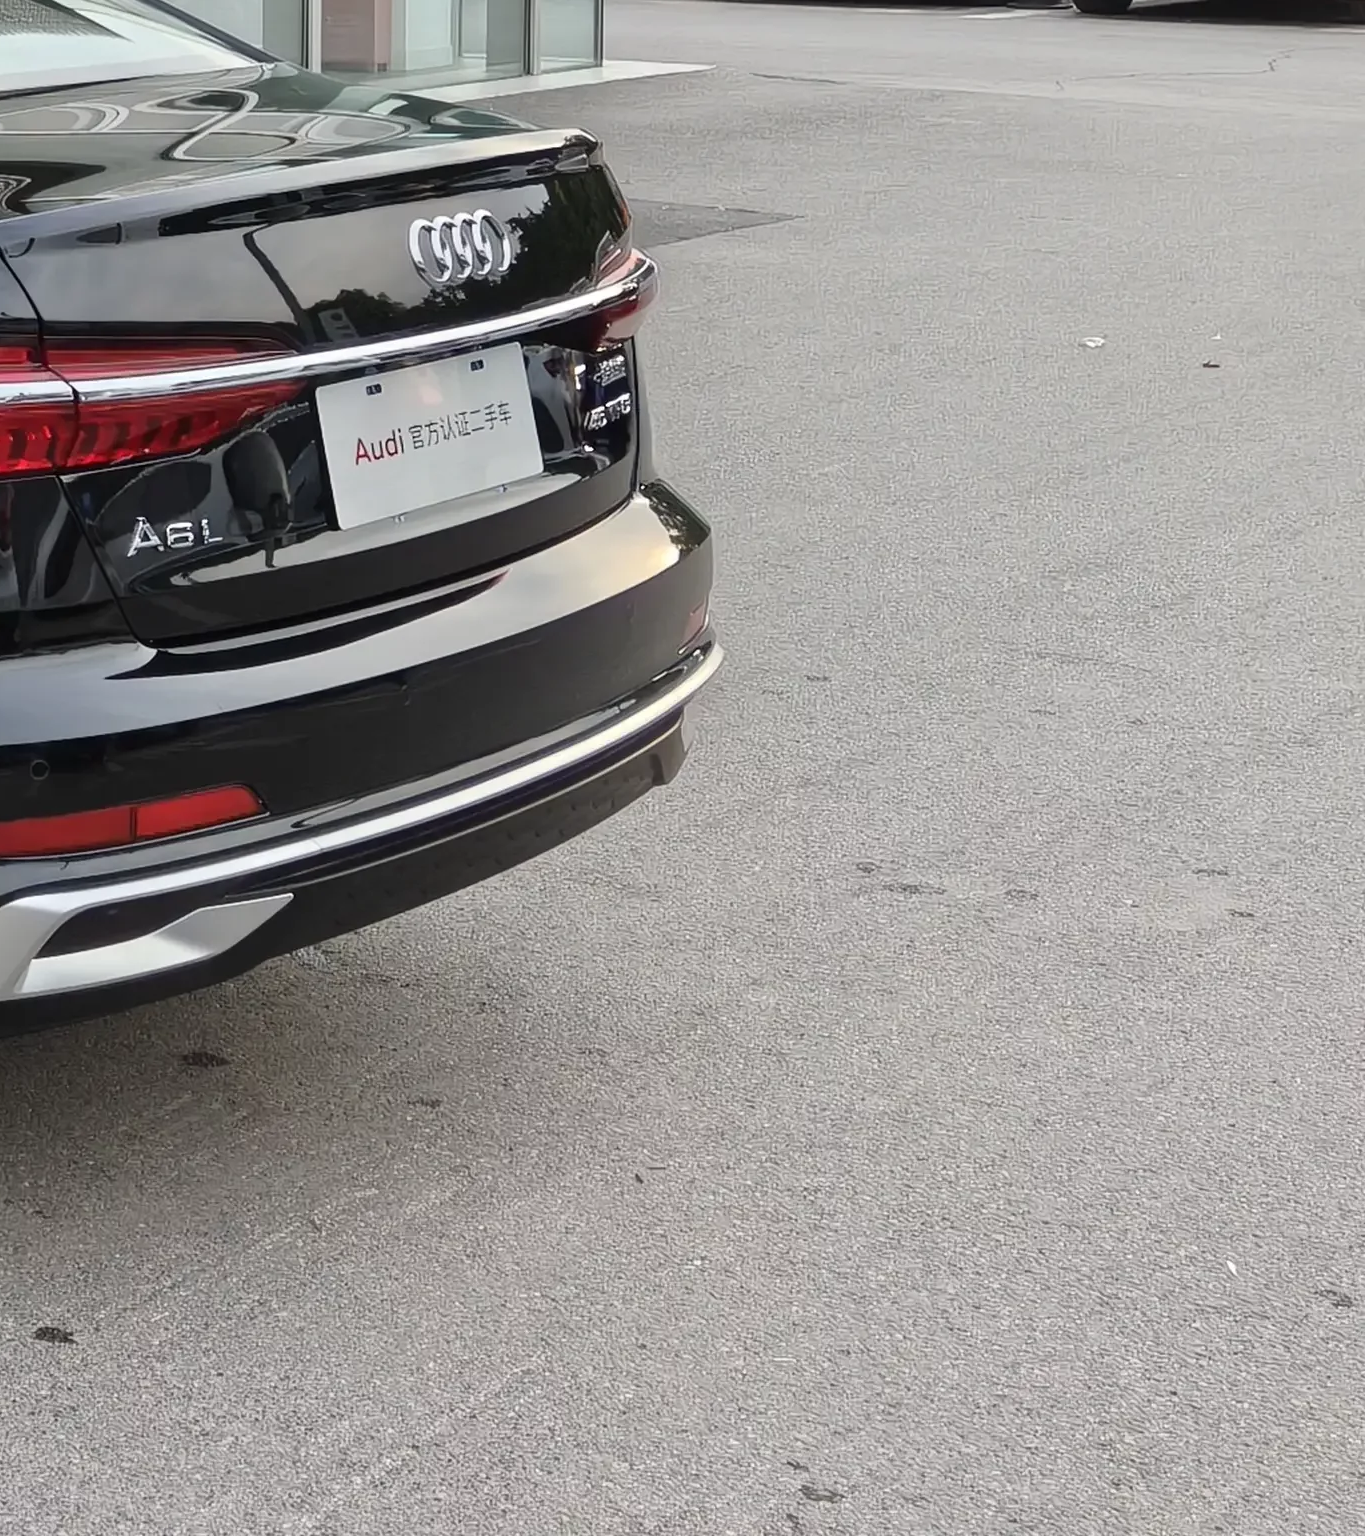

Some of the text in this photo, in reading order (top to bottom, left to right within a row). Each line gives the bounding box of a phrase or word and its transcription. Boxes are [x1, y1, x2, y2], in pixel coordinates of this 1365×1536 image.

[355, 401, 512, 466] Audi 官方认证二手车
[127, 516, 223, 557] A6L
